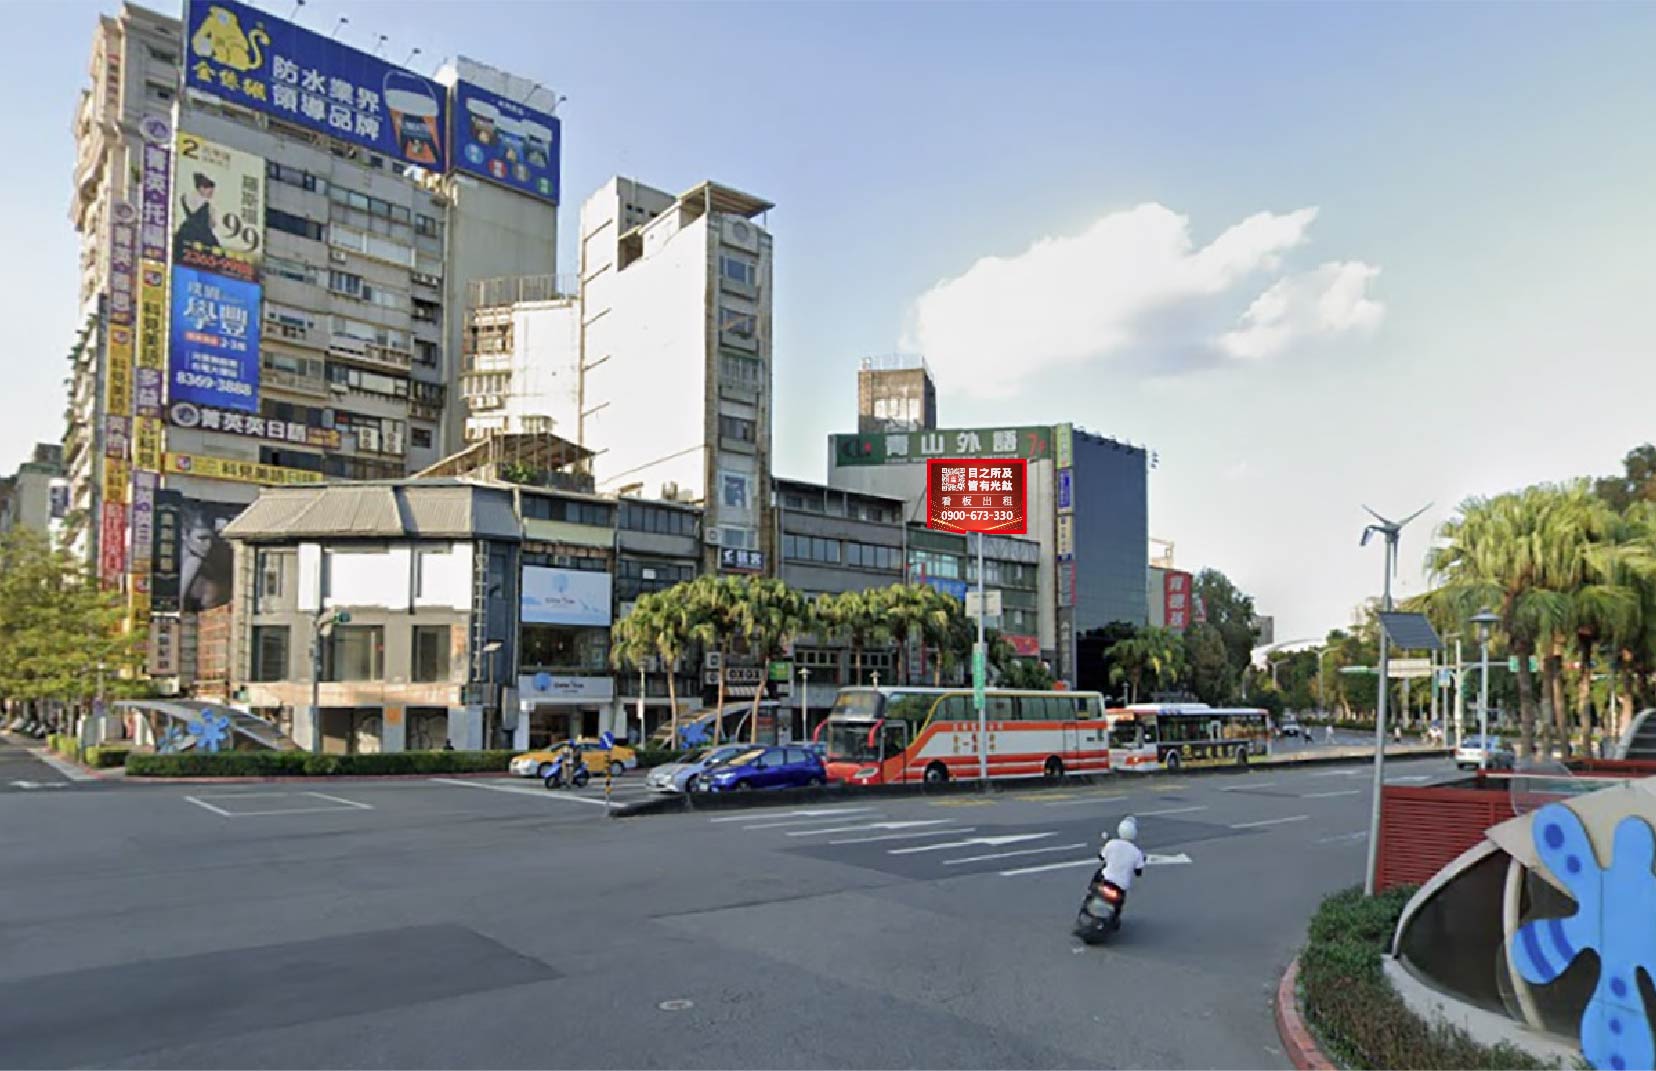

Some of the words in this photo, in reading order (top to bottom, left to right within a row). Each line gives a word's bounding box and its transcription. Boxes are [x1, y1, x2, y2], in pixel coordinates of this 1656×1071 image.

[272, 54, 380, 113] 防水業界
[272, 83, 381, 141] 領導品牌
[182, 138, 199, 160] 2
[222, 212, 260, 253] 99
[886, 430, 1017, 457] 青山外語
[968, 467, 1013, 479] 目之所及
[968, 480, 1013, 492] 皆有光鈦
[942, 496, 1013, 506] 看板出租
[941, 510, 1014, 521] 0900-673-330
